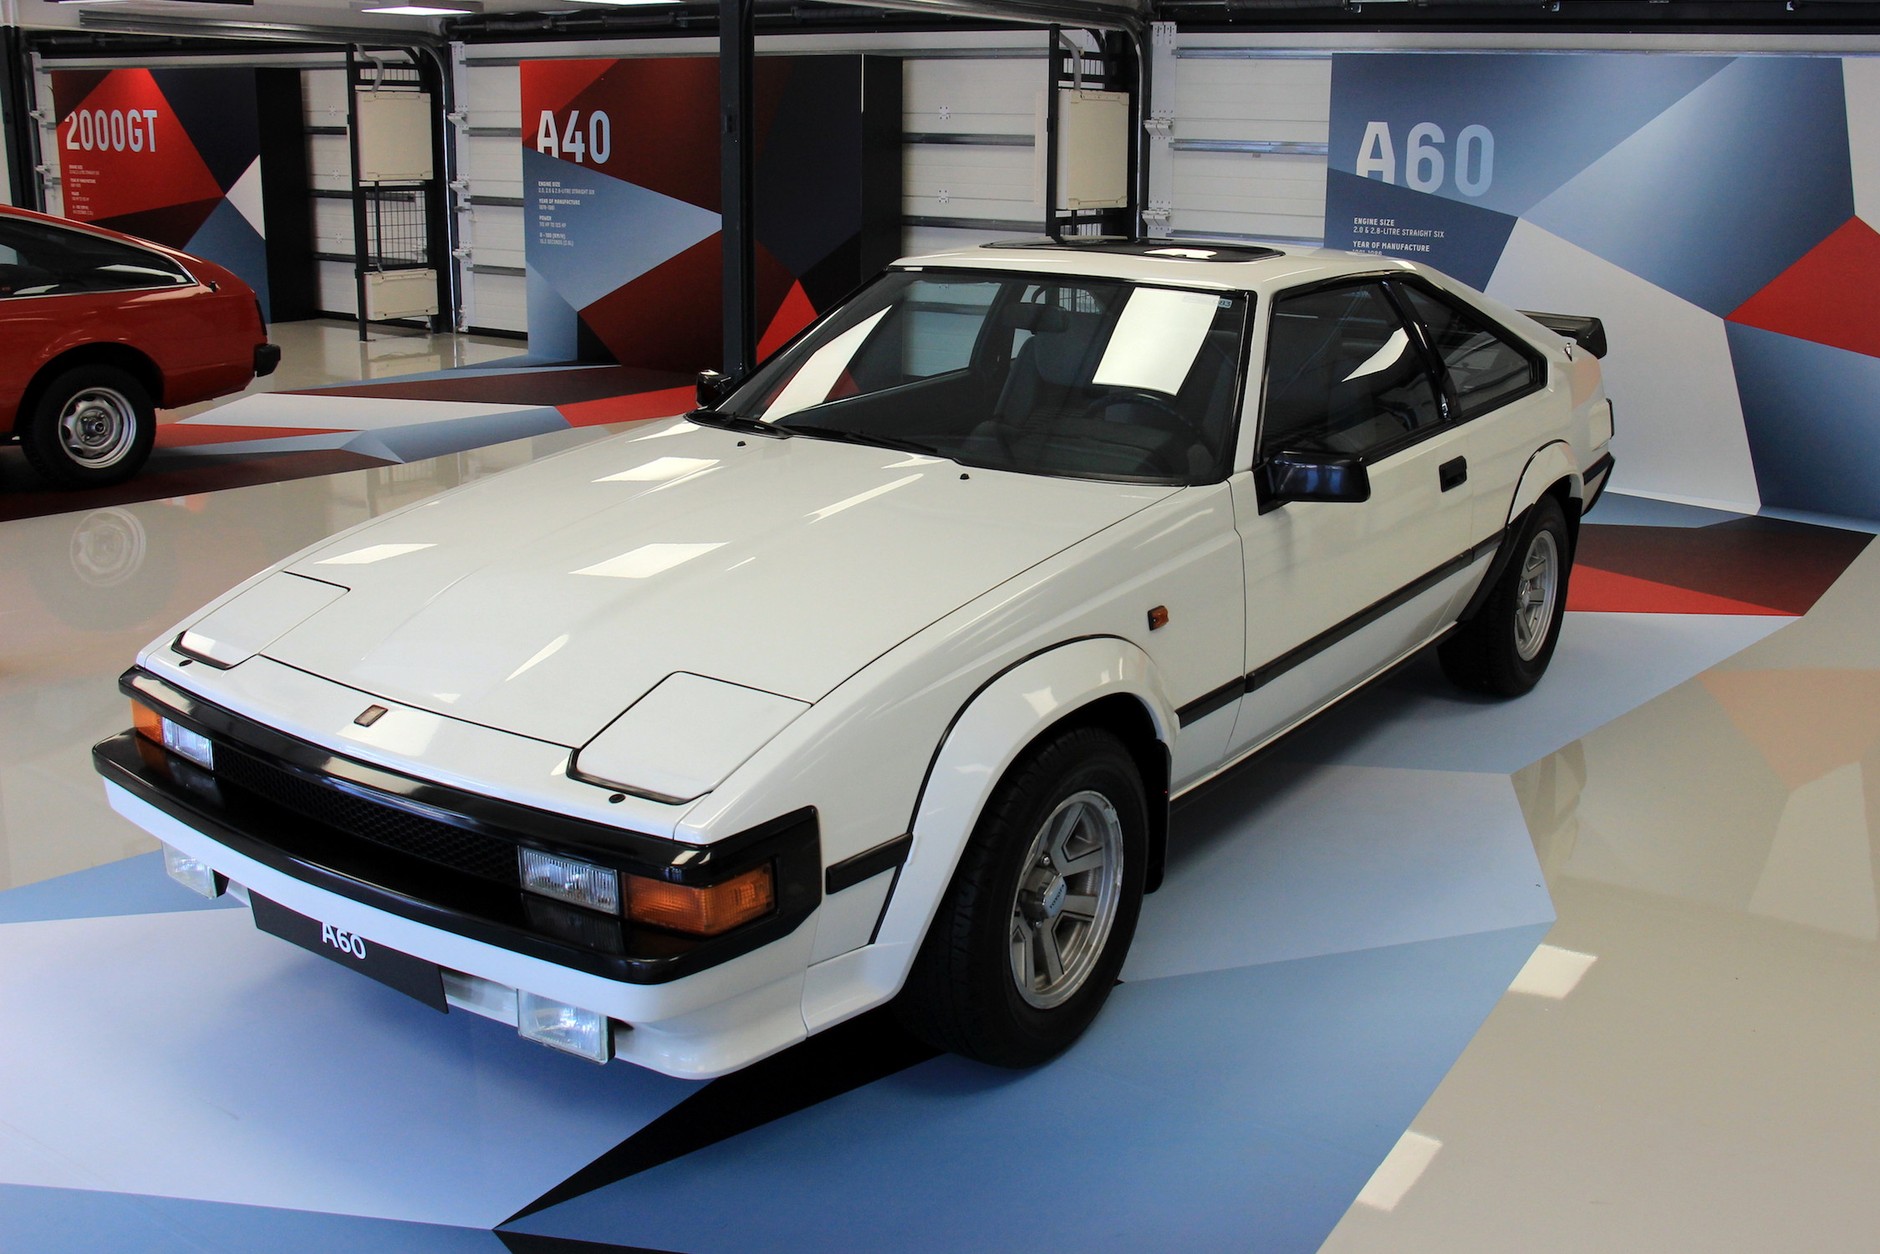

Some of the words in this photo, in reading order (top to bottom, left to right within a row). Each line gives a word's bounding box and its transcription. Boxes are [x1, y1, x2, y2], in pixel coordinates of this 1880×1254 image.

[64, 109, 158, 153] 2000GT
[537, 110, 611, 165] A40
[1356, 121, 1495, 197] A60
[1354, 218, 1378, 226] ENGINE
[1354, 226, 1363, 234] 2.0
[1370, 227, 1400, 236] 2.8-LITRE
[1402, 229, 1432, 238] STRAIGHT
[1434, 230, 1445, 239] SIX
[1352, 241, 1370, 249] YEAR
[1381, 242, 1430, 253] MANUFACTURE
[322, 921, 367, 960] A60
